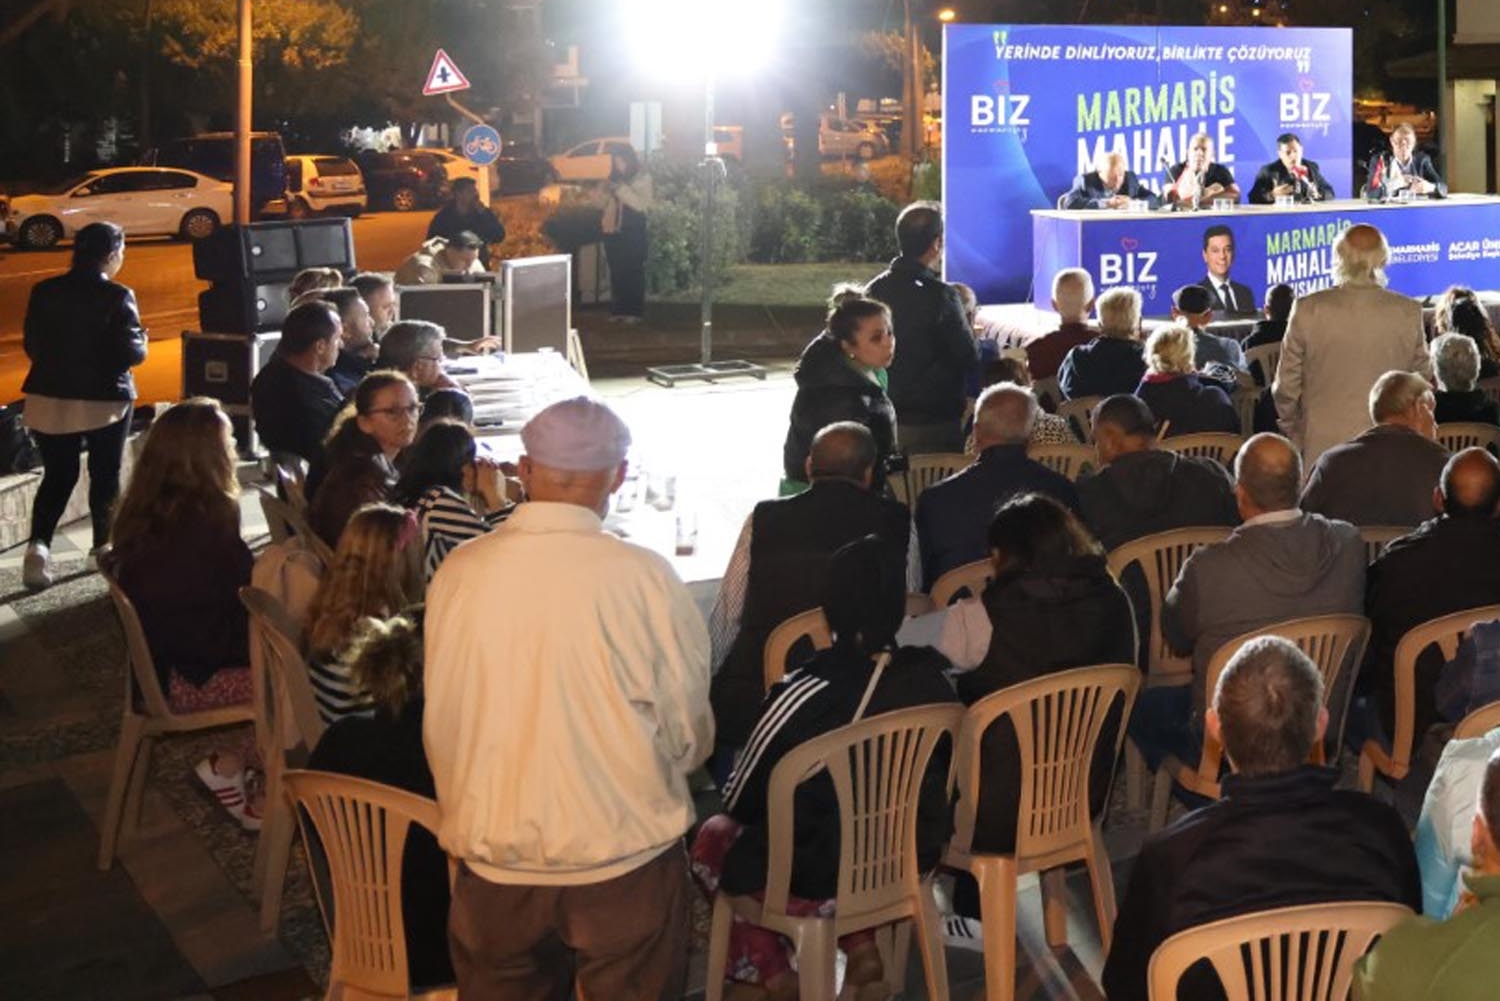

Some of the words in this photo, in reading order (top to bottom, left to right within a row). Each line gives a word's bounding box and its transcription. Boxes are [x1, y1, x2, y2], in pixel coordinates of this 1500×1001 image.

[995, 43, 1061, 60] YERİNDE
[1077, 70, 1236, 133] MARMARİS
[1077, 117, 1235, 178] MAHALE
[1448, 240, 1480, 253] ACAR
